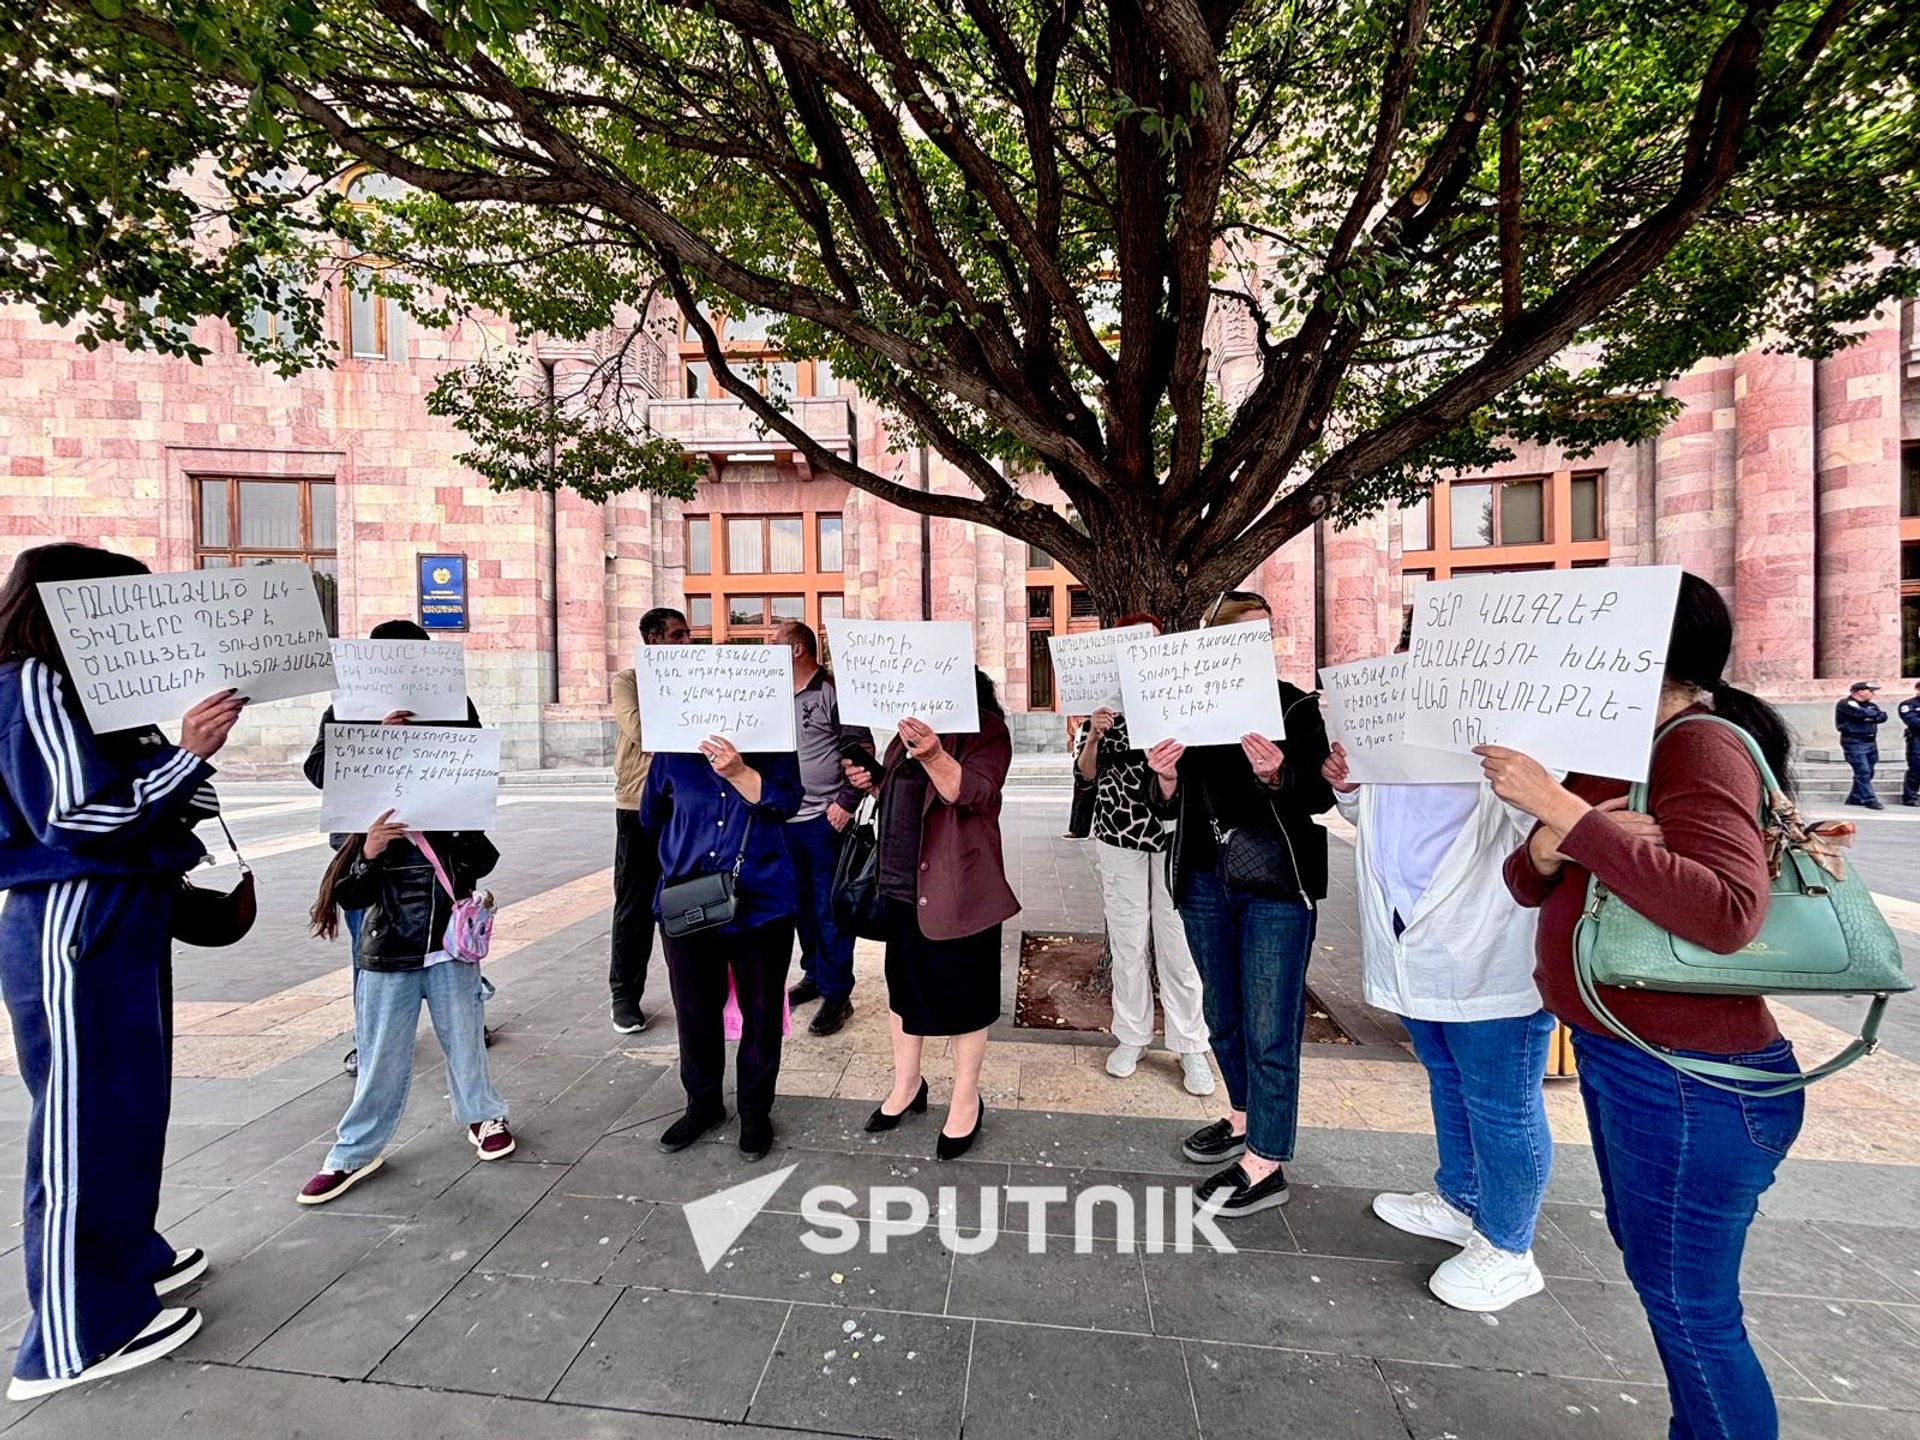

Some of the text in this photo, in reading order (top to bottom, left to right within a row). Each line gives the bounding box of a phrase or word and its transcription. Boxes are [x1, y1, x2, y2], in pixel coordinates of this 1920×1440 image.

[194, 607, 254, 628] ՊԵՏՔ
[1479, 591, 1619, 625] ԿԱՆԳՆԵՔ
[1410, 676, 1448, 711] ՎԱԾ
